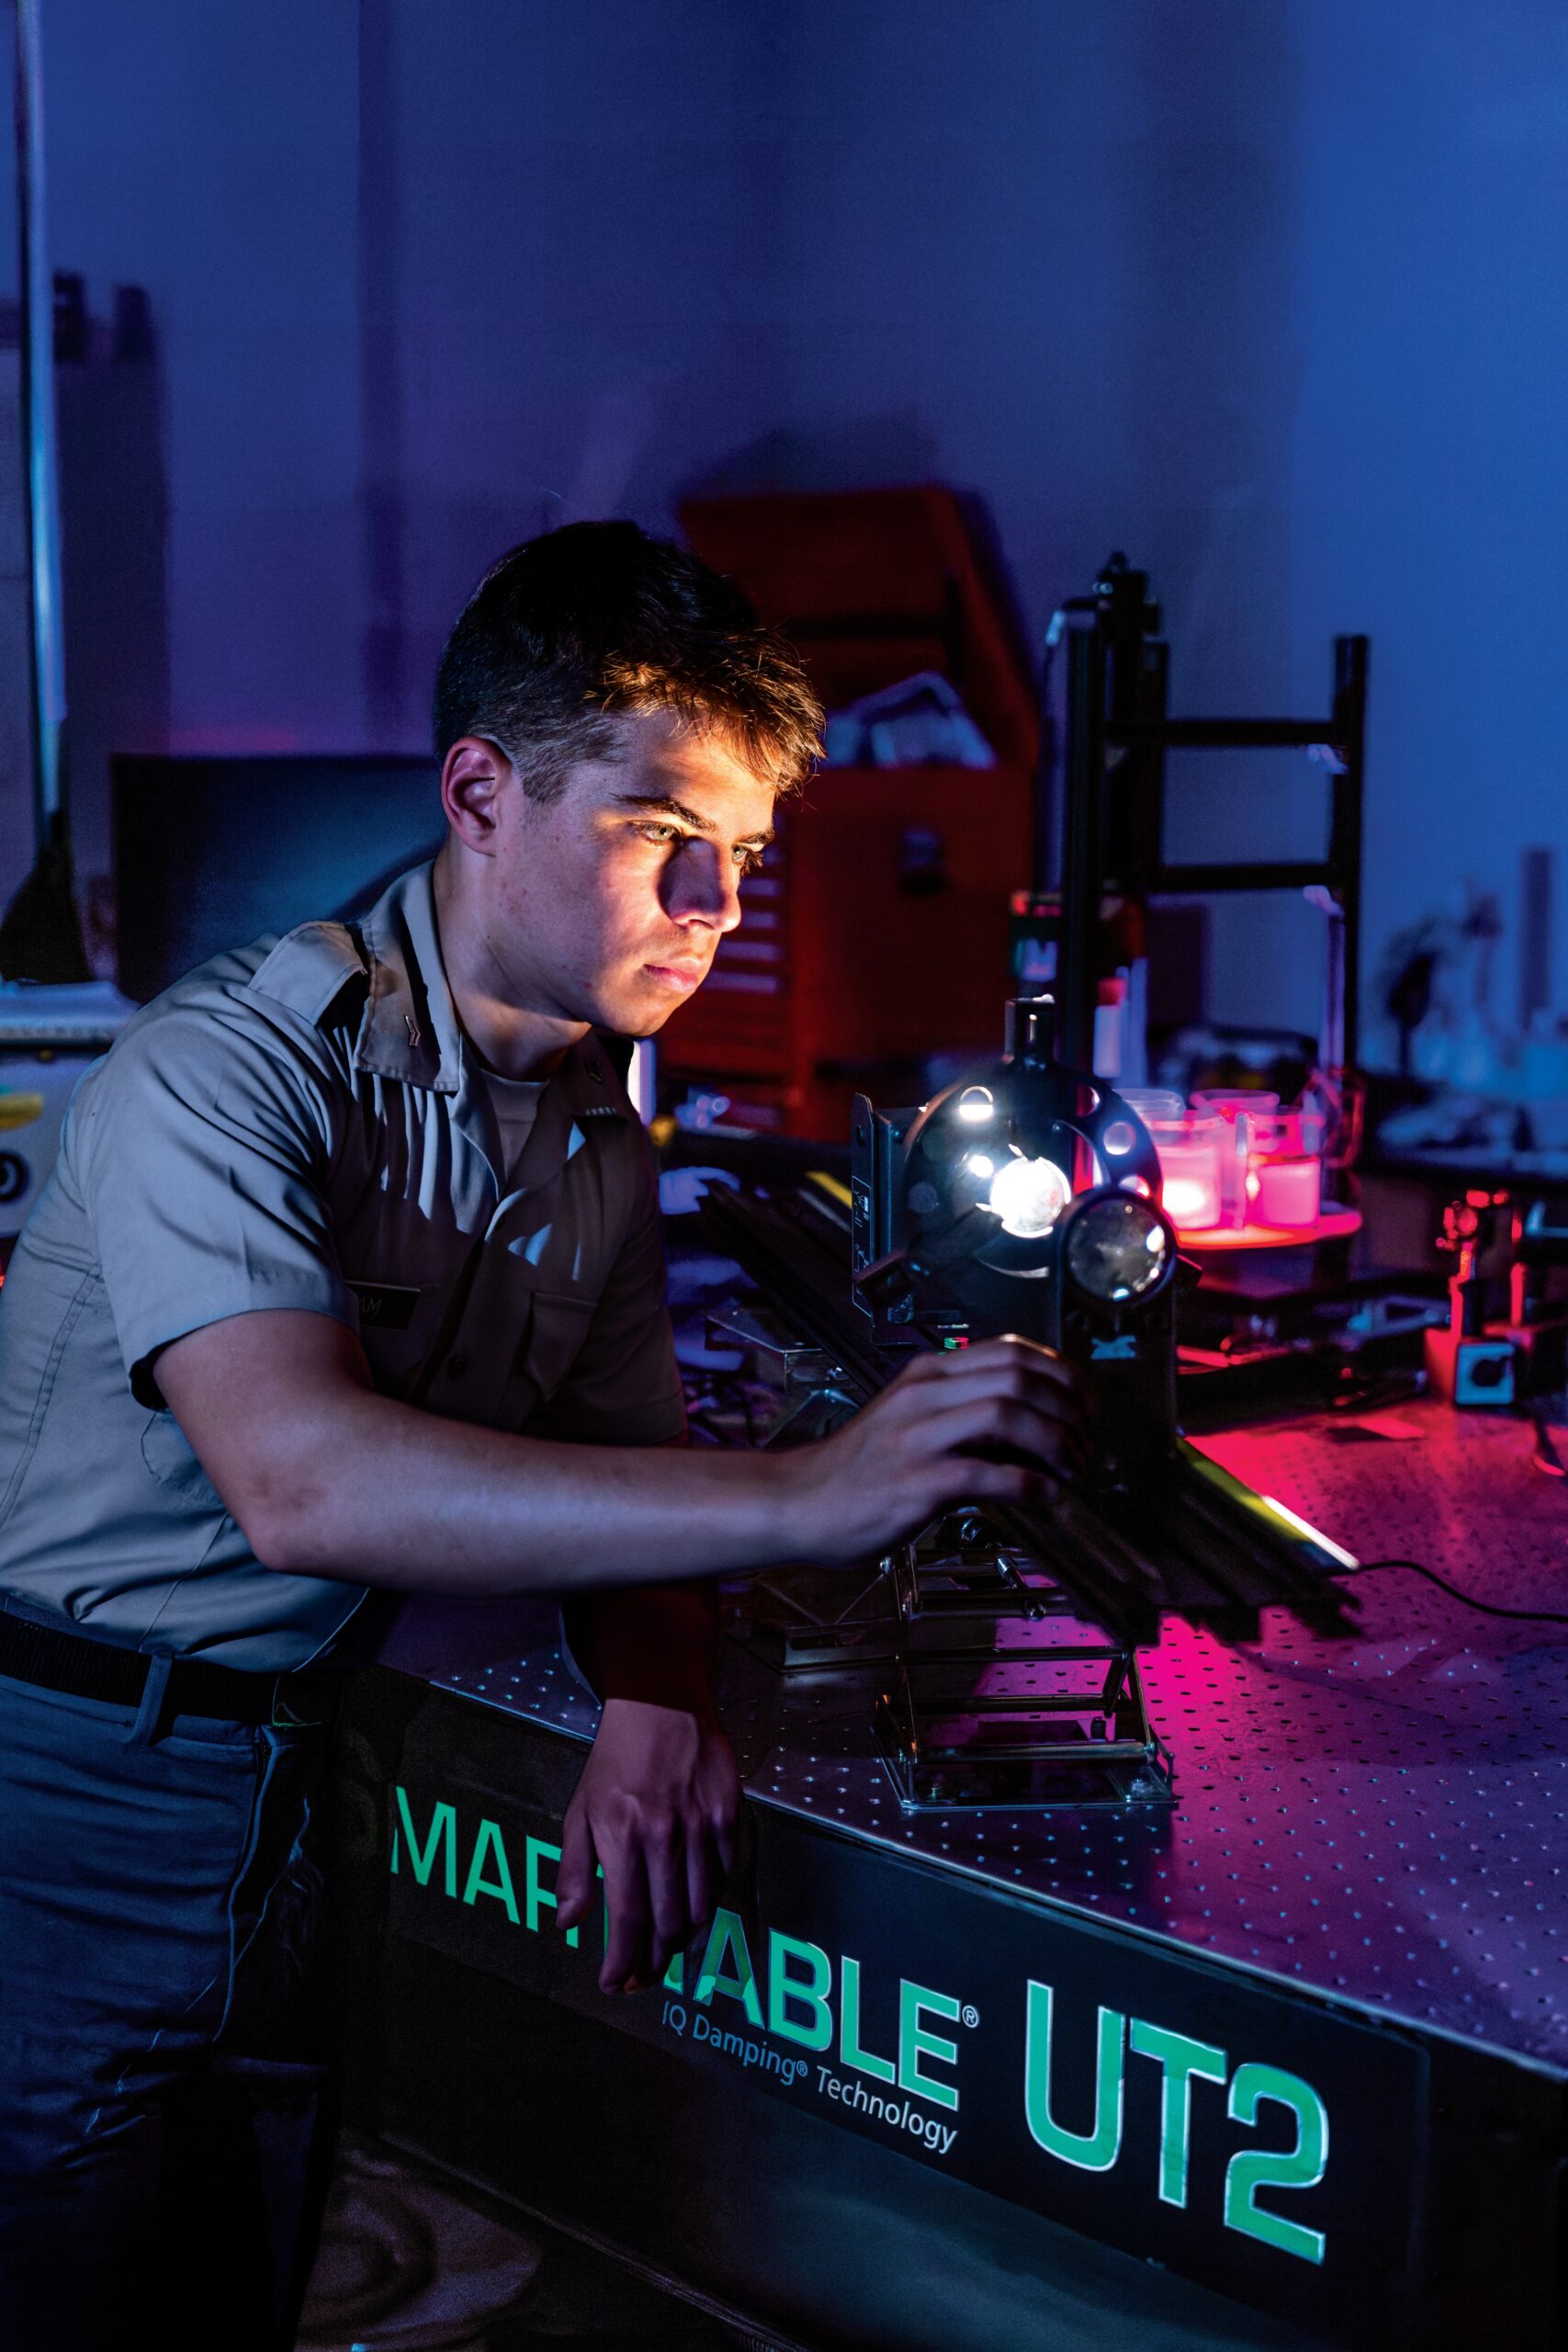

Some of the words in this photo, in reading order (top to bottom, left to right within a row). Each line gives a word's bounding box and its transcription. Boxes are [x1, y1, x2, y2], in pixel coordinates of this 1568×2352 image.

[661, 2001, 687, 2036] IQ
[693, 2013, 808, 2086] Damping®
[817, 2066, 958, 2154] Technology
[1024, 1979, 1329, 2266] UT2
